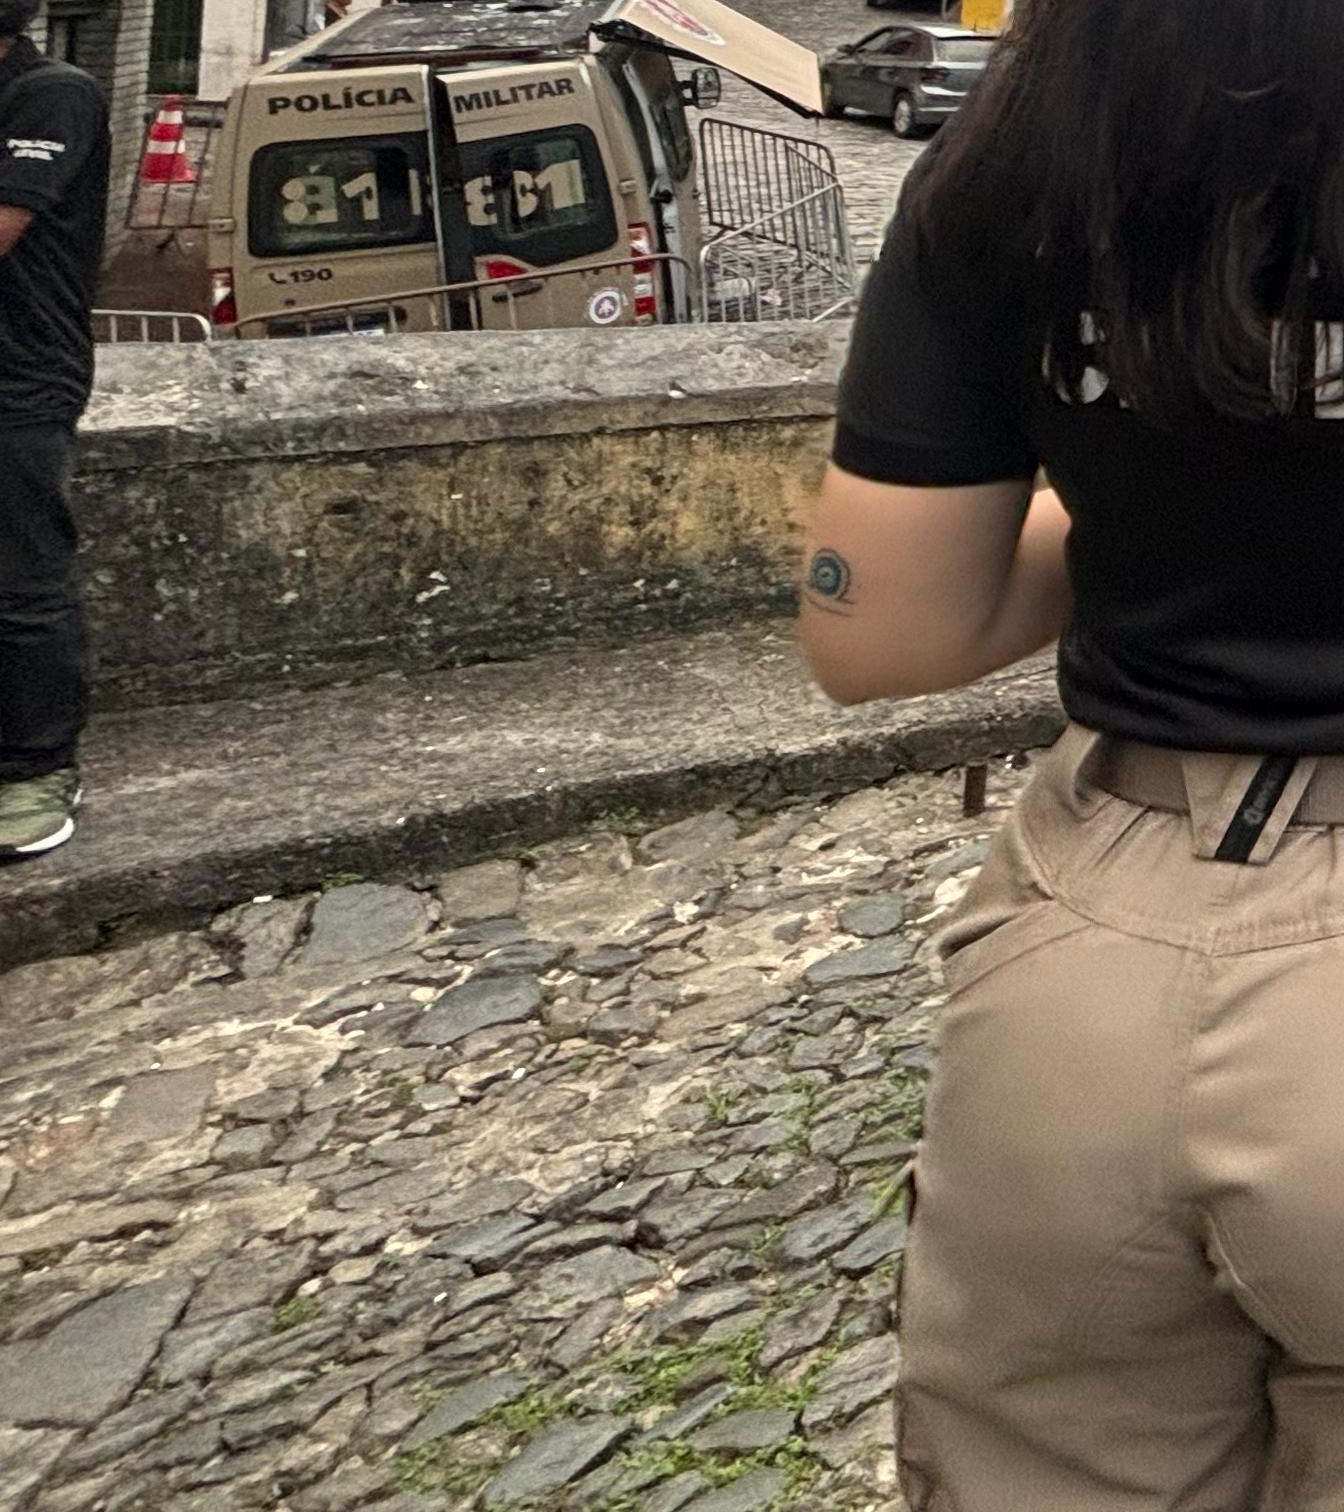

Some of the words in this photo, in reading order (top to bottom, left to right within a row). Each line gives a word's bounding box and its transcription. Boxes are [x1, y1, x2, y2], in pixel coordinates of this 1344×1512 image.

[267, 87, 415, 115] POLÍCIA
[453, 77, 576, 113] MILITAR
[290, 267, 333, 283] 190
